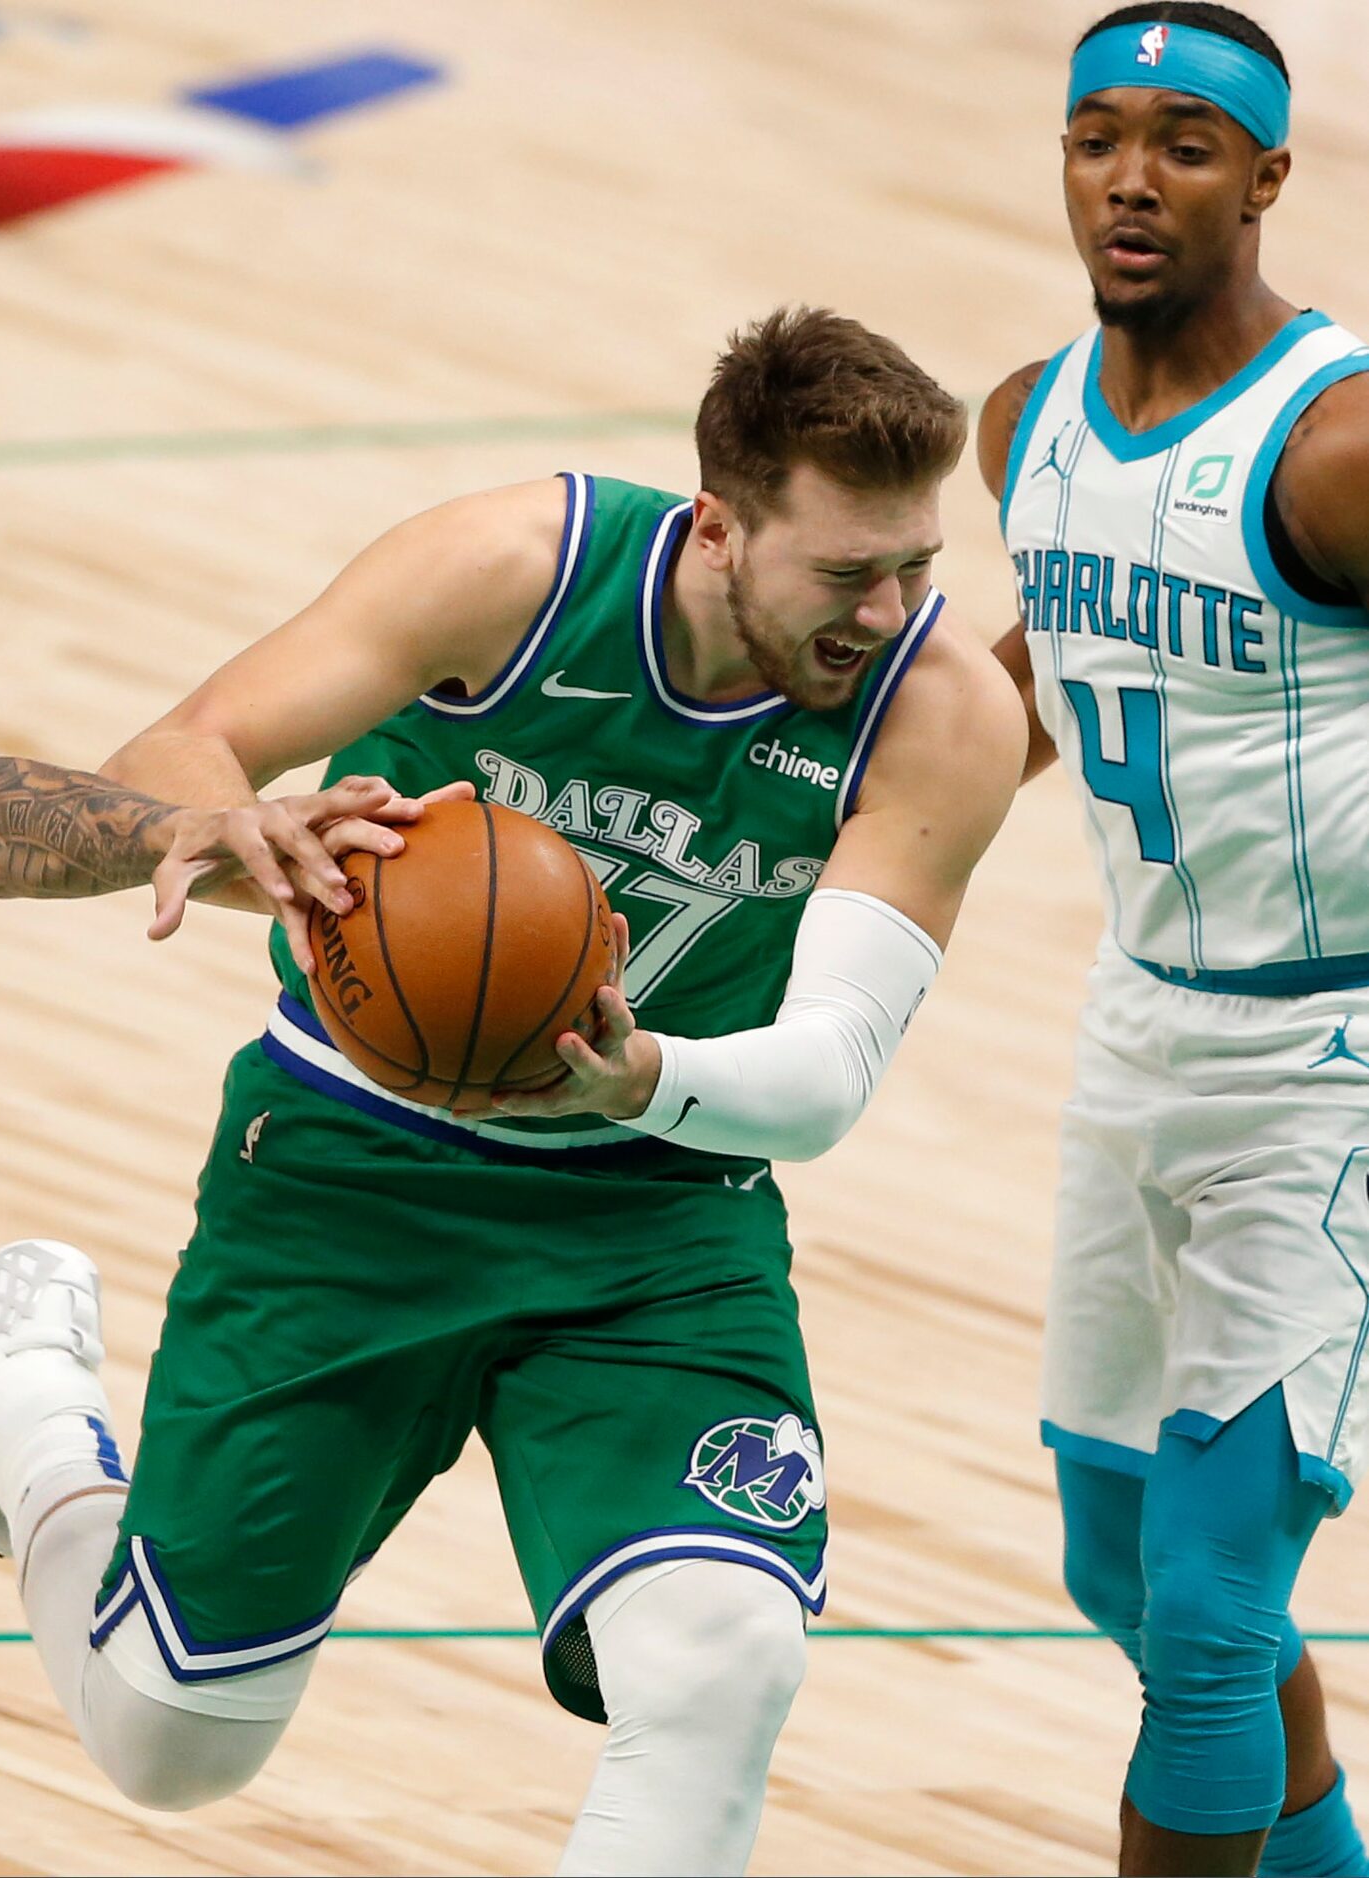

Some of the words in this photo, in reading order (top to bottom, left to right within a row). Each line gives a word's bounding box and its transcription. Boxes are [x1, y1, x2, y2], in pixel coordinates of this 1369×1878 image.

[1174, 498, 1228, 518] lendingtree
[748, 738, 840, 790] chime
[1061, 679, 1176, 866] 4
[475, 749, 828, 898] DALLAS
